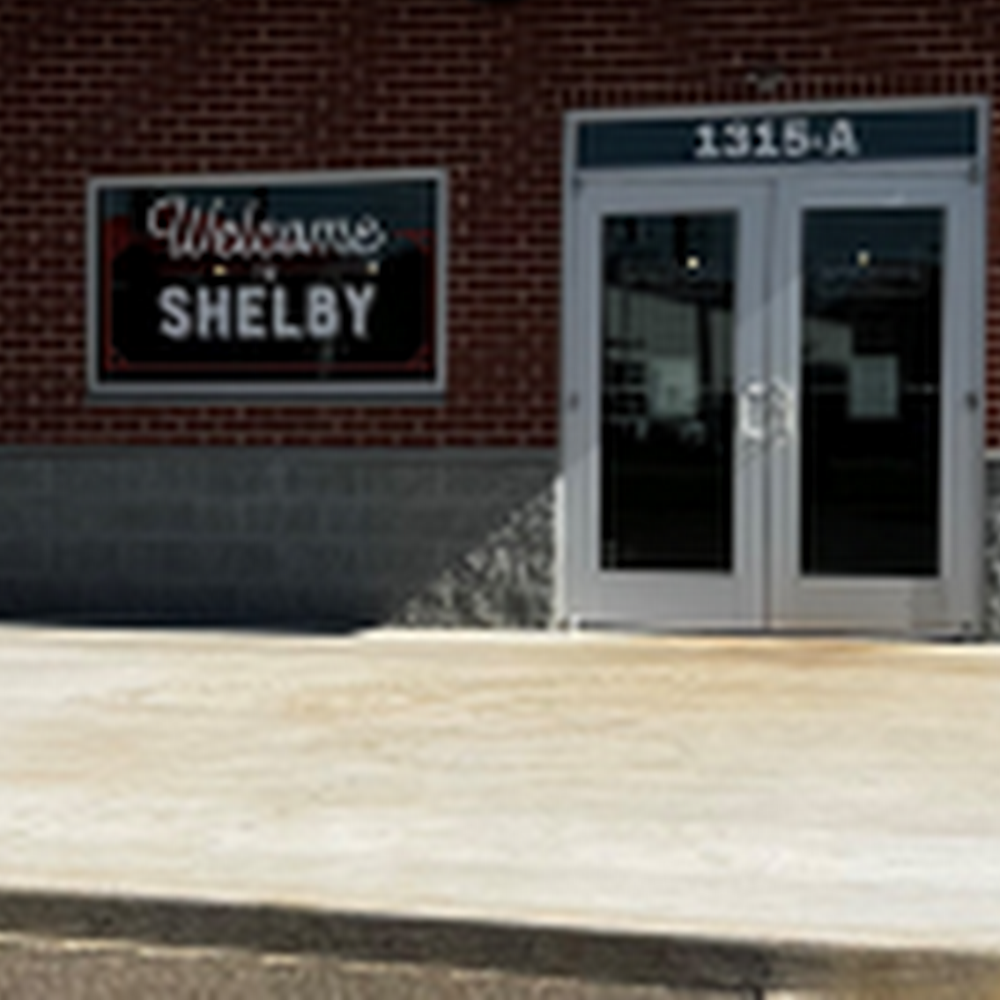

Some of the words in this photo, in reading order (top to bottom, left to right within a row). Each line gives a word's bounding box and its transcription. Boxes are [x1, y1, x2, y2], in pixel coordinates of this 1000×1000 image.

[694, 117, 861, 159] 1315-A
[146, 194, 388, 261] Welcome
[157, 283, 379, 341] SHELBY
